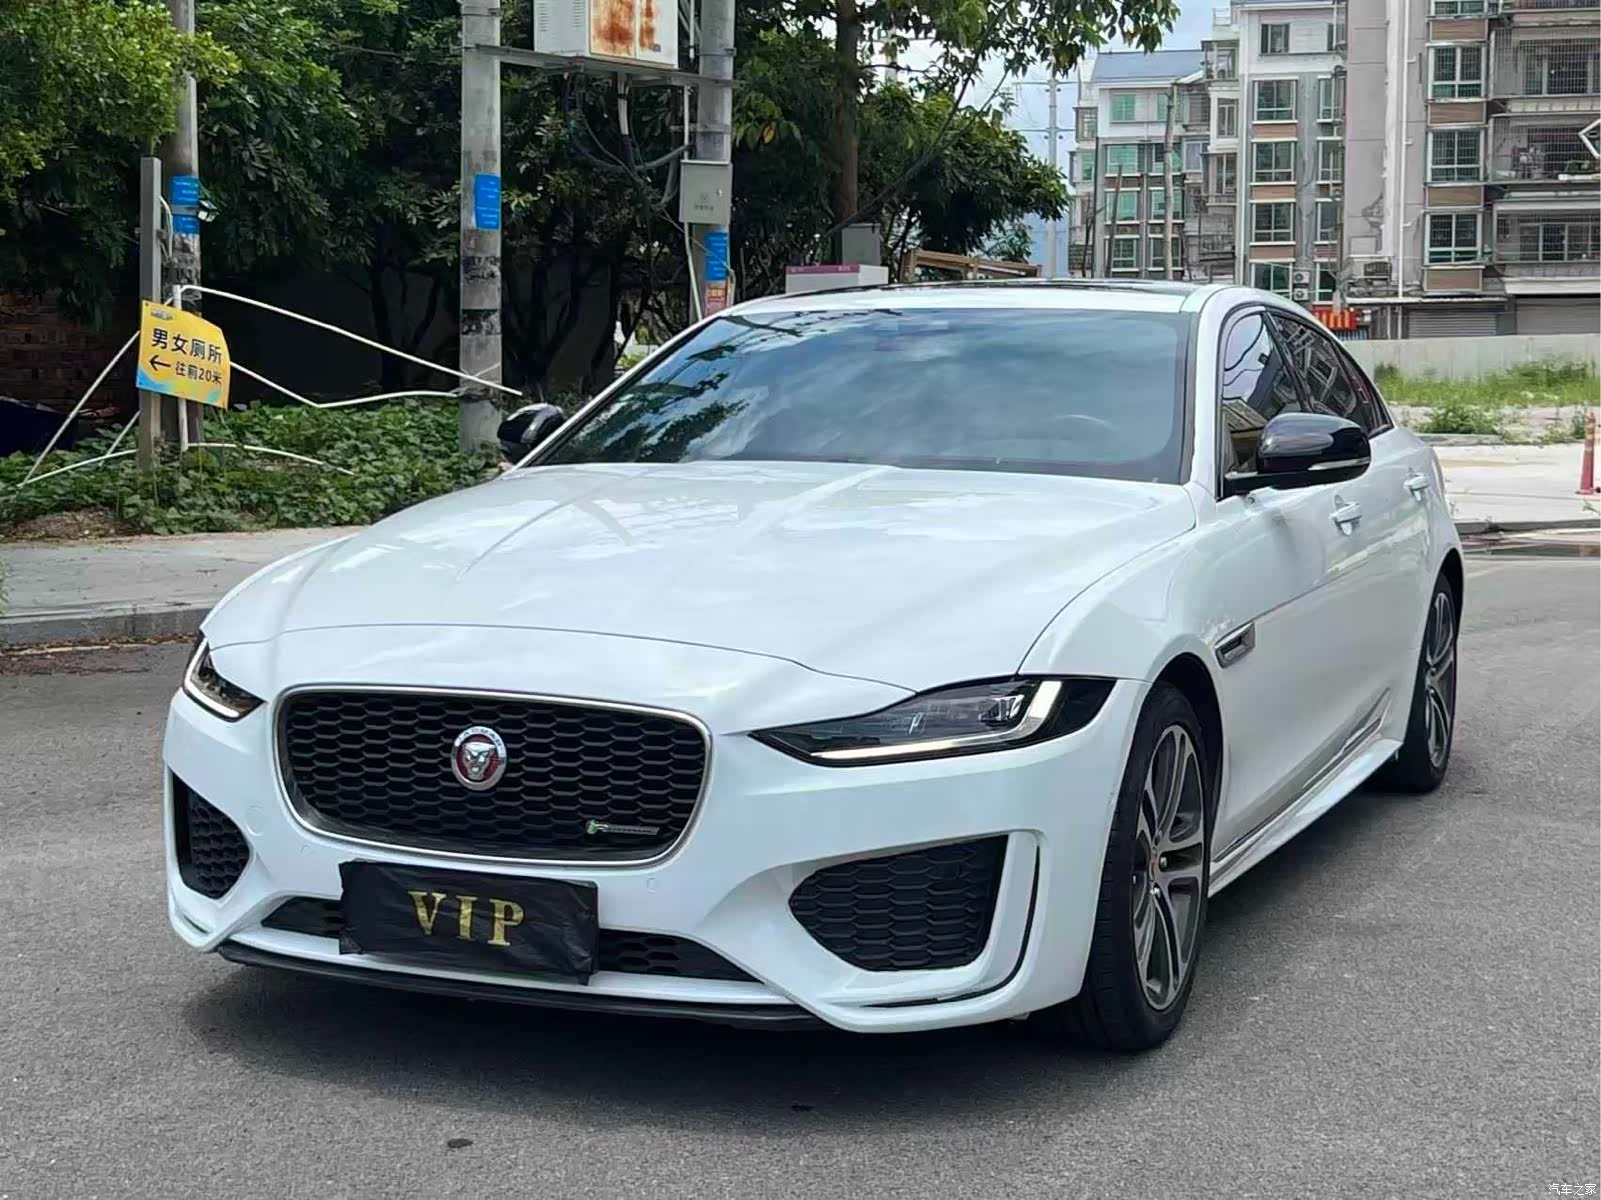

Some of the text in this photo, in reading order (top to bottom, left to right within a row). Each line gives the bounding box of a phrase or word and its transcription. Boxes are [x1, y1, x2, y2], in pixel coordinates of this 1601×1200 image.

[151, 328, 222, 364] 男女厕所
[175, 361, 222, 385] 往前20米
[407, 891, 524, 946] VIP
